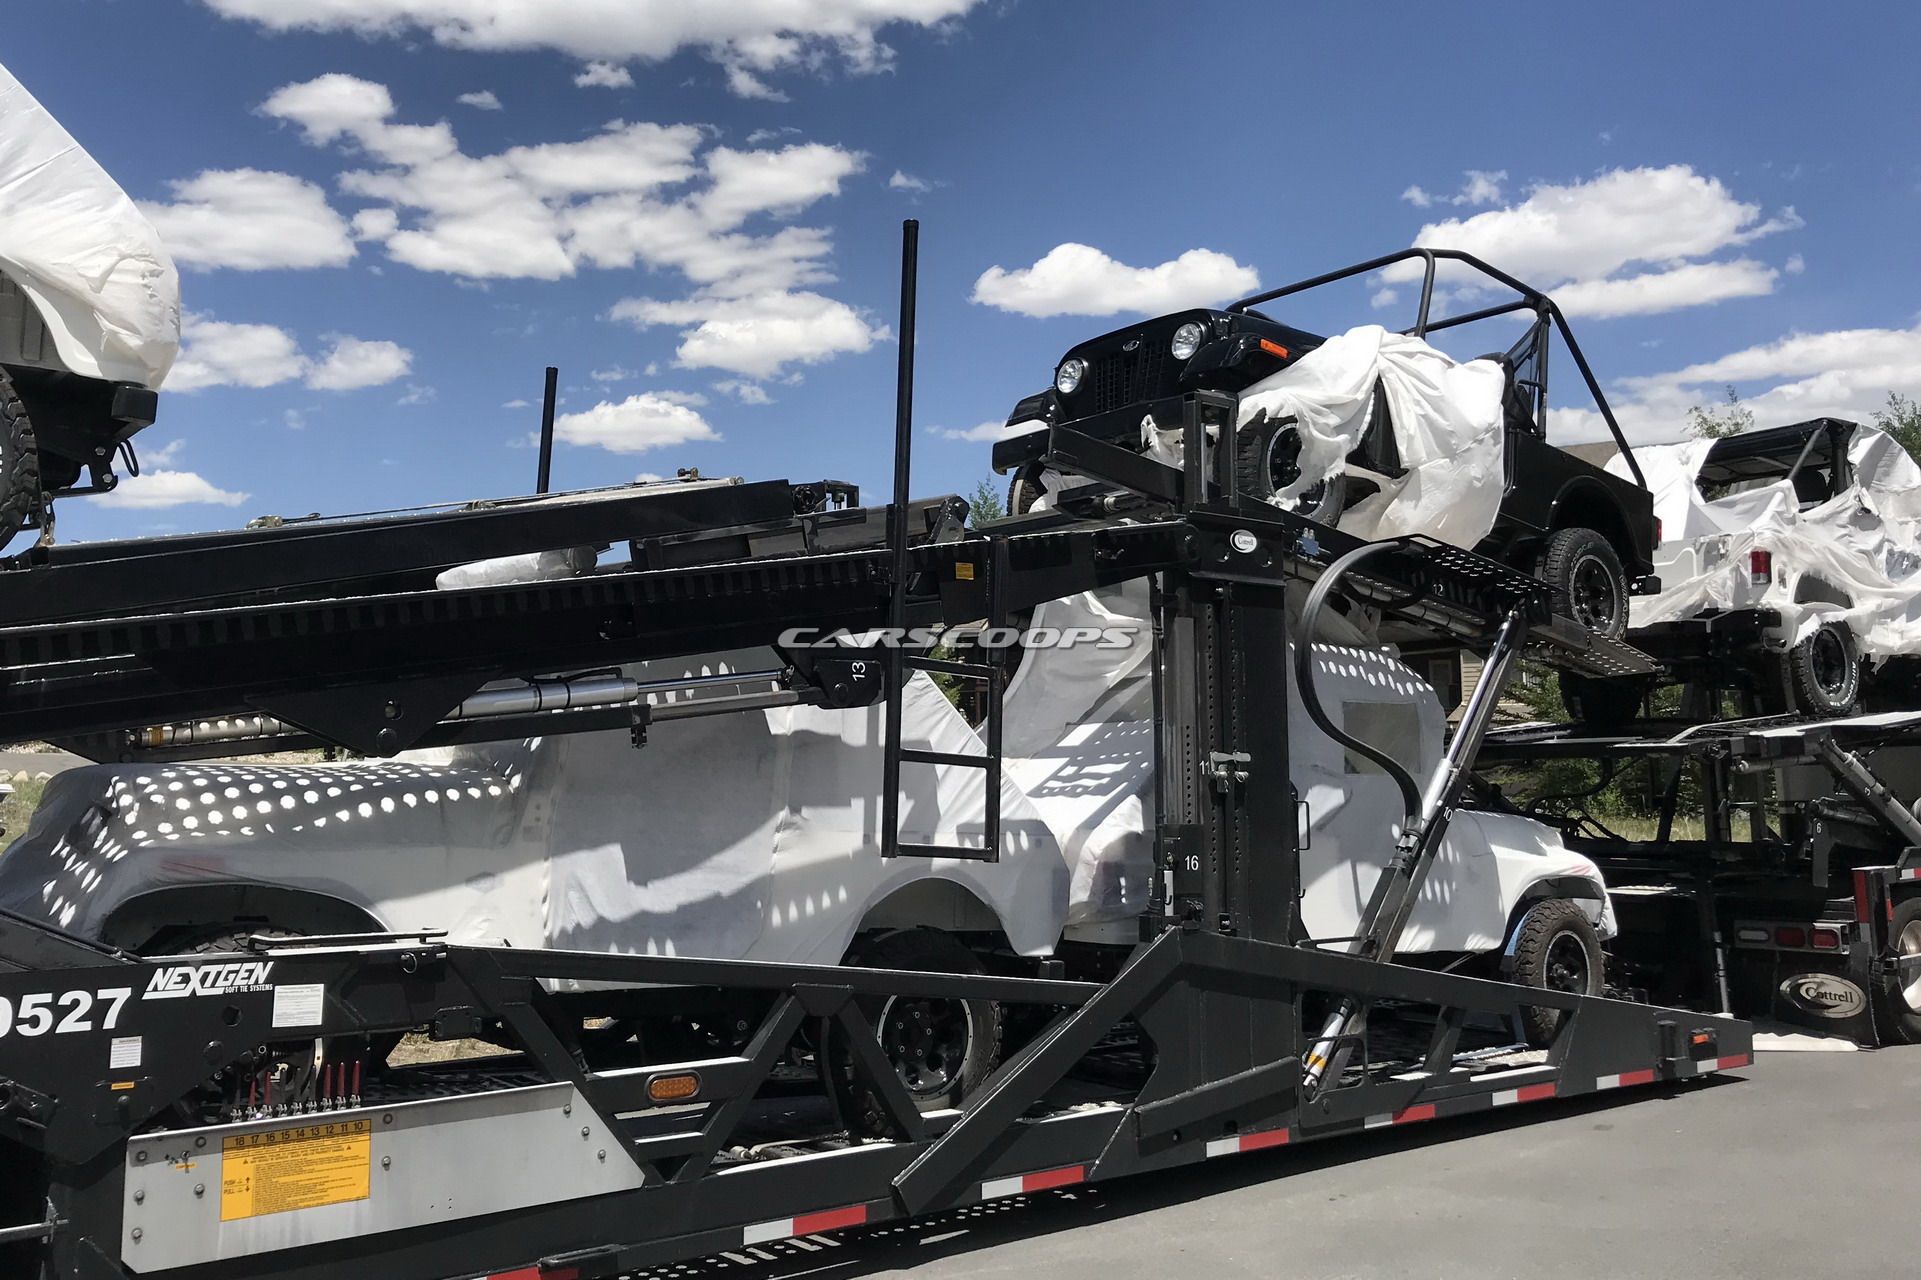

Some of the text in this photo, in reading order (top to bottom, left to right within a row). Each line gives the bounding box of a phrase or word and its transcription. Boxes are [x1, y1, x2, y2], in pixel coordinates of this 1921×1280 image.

[1433, 583, 1444, 597] 12
[852, 662, 865, 681] 13
[1443, 806, 1453, 822] 10
[1816, 822, 1822, 834] 6
[1184, 855, 1199, 871] 16
[142, 961, 274, 1000] NEXTGEN
[225, 984, 273, 994] SOFT TIE SYSTEMS
[1805, 986, 1854, 1003] Cottrell
[234, 1121, 363, 1146] 18 17 16 15 14 13 12 11 10
